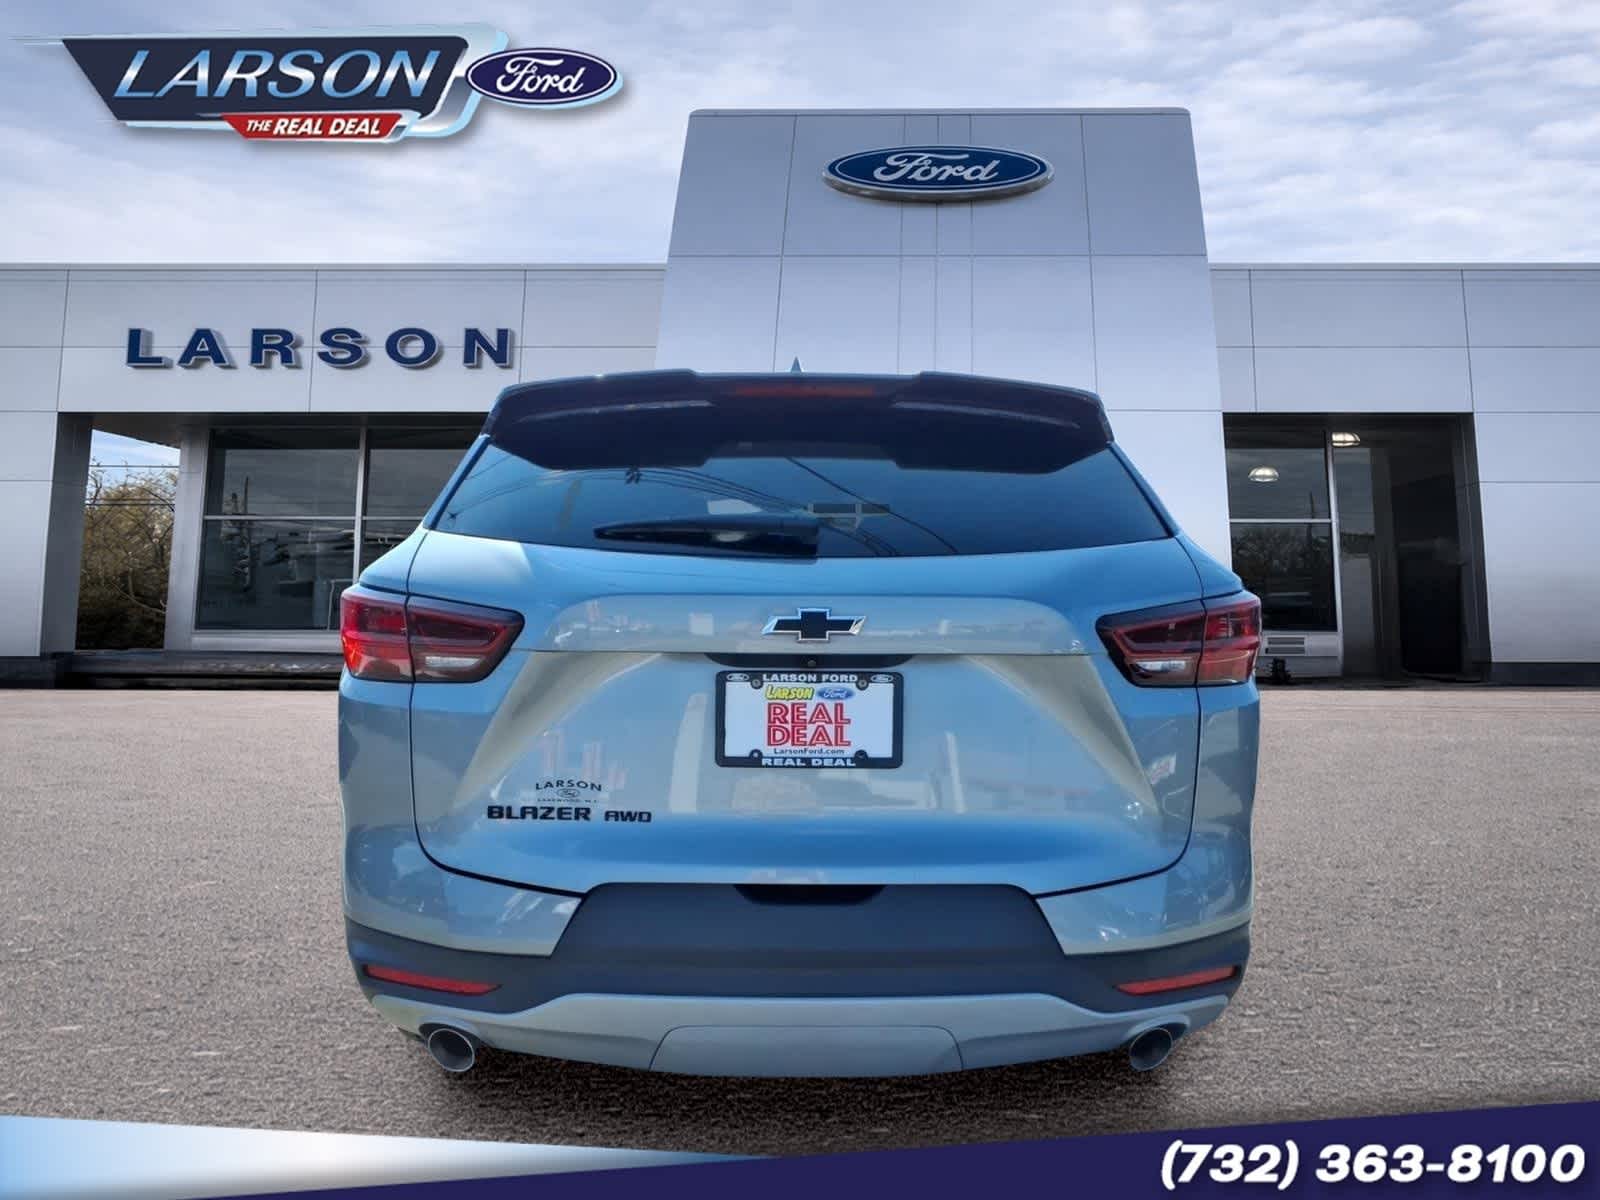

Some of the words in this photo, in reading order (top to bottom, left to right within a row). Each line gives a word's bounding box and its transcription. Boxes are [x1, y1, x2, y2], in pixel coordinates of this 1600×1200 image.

[873, 152, 1000, 181] Ford
[126, 327, 515, 369] LARSON
[762, 674, 817, 683] LARSON
[822, 674, 858, 683] FORD
[767, 703, 851, 725] REAL
[767, 725, 851, 747] DEAL
[773, 747, 845, 756] LarsonFord.com
[761, 757, 806, 767] REAL
[811, 757, 856, 767] DEAL
[535, 779, 602, 792] LARSON
[487, 805, 591, 821] BLAZER
[604, 810, 652, 823] AWD
